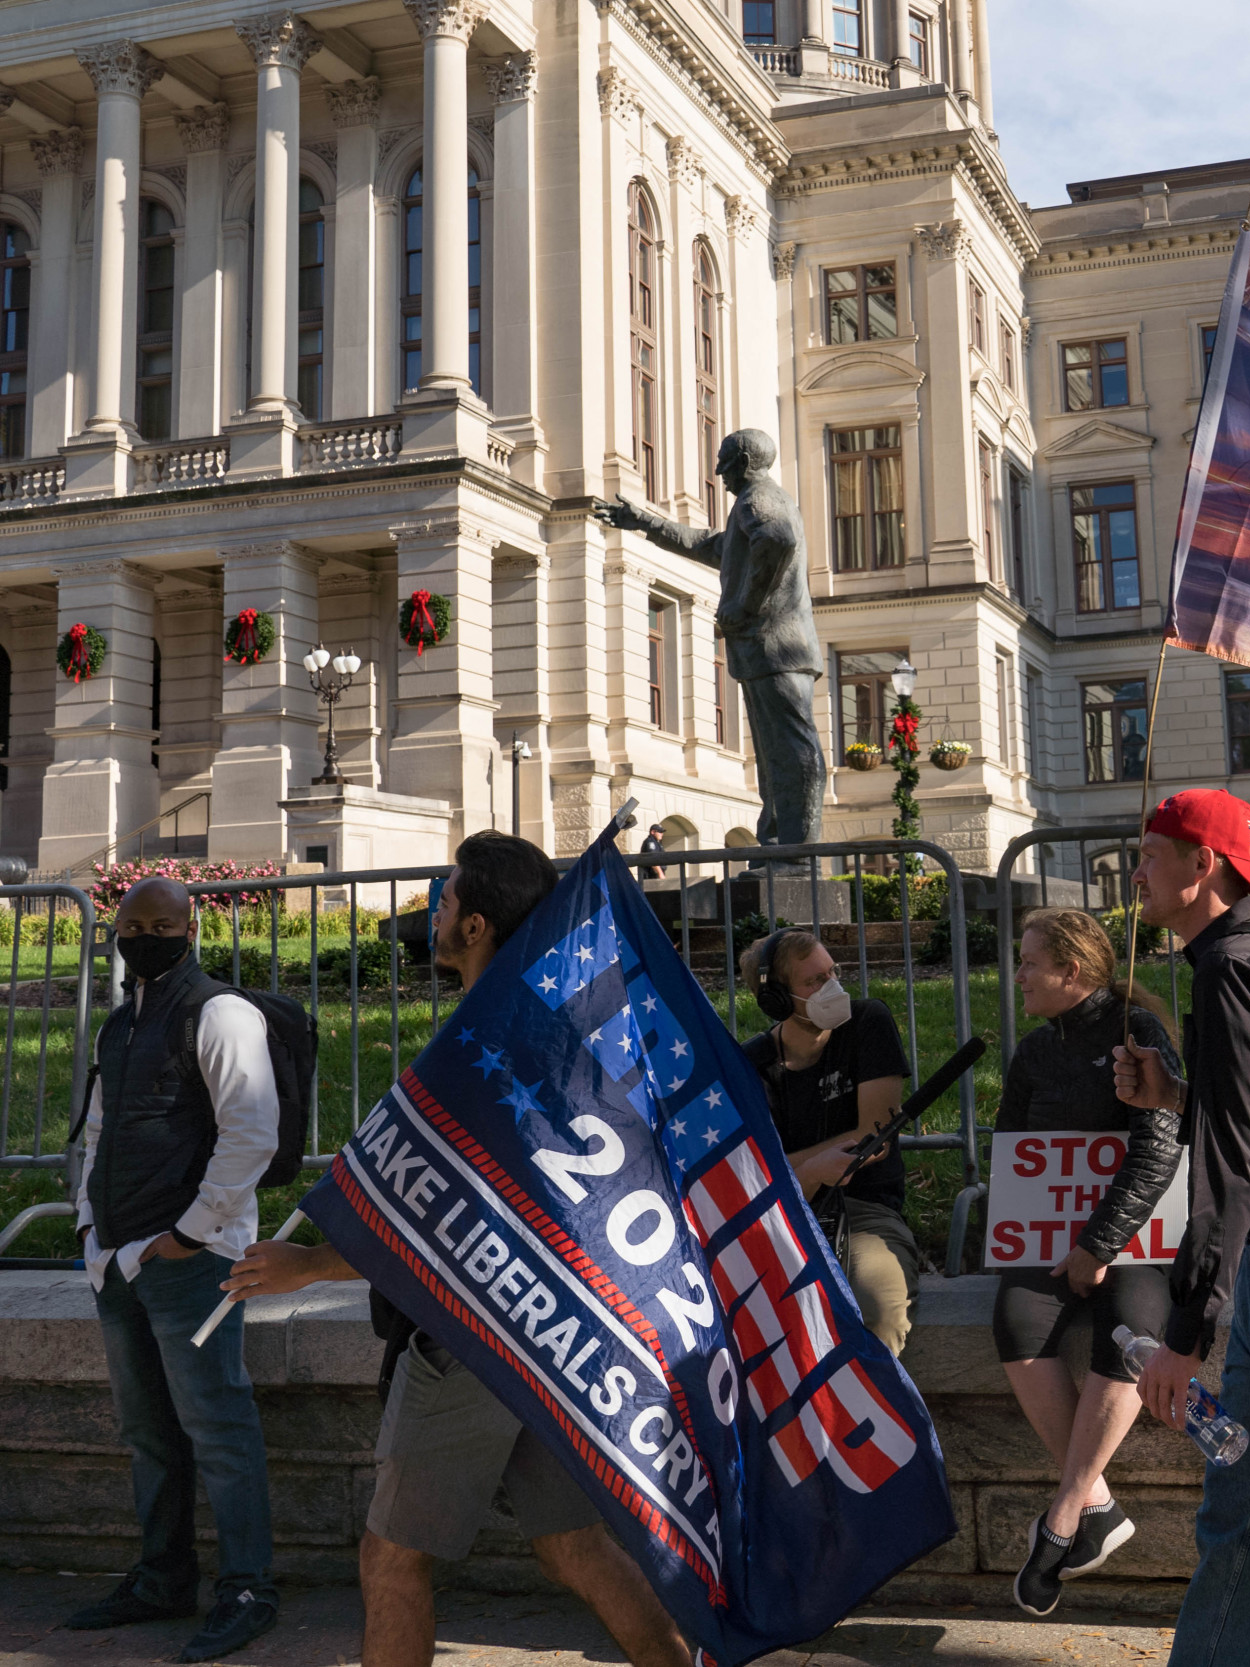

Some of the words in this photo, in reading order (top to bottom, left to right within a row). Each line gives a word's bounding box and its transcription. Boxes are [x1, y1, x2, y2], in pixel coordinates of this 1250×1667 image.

[355, 1099, 450, 1220] MAKE
[434, 1198, 637, 1416] LIBERALS
[629, 1405, 710, 1507] CRY
[521, 868, 917, 1494] TRUMP
[530, 1114, 738, 1426] 2020
[1013, 1136, 1127, 1178] STO
